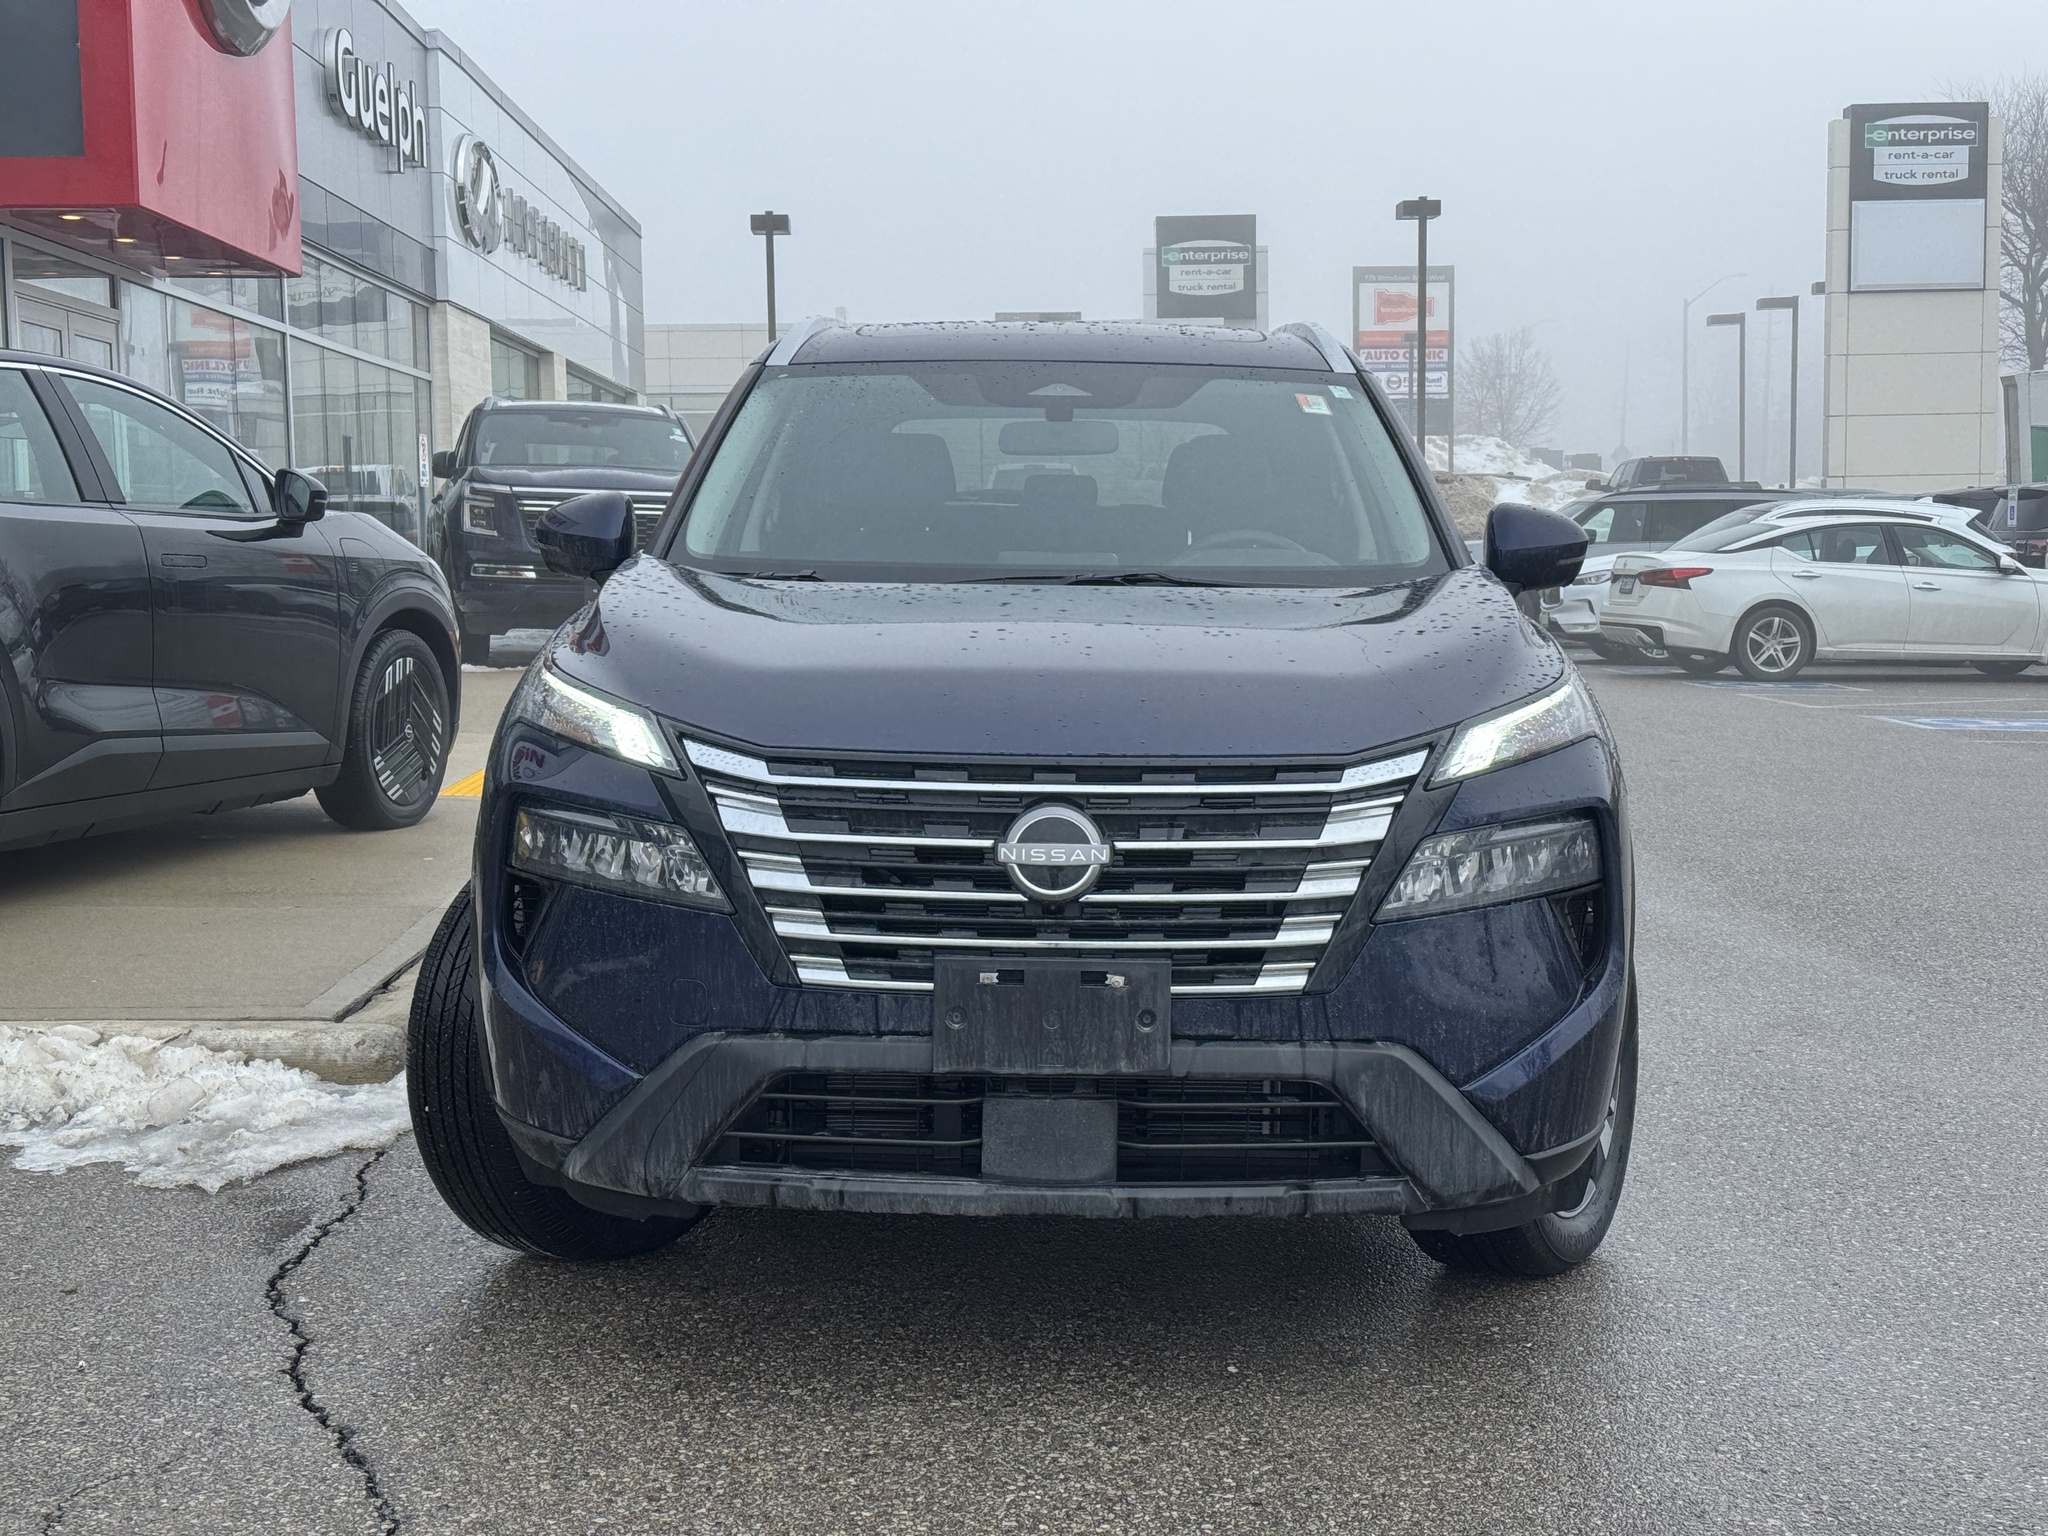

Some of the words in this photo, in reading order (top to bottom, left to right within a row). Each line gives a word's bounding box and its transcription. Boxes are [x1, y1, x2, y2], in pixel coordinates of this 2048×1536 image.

[334, 27, 428, 174] Guelph
[1870, 126, 1976, 143] enterprise
[1888, 150, 1955, 160] rent-a-car
[1884, 169, 1918, 180] truck
[1921, 168, 1959, 179] rental
[1167, 249, 1249, 262] enterprise
[1180, 268, 1232, 276] rent-a-car
[1177, 282, 1204, 291] truck
[1206, 282, 1236, 290] rental
[1364, 350, 1400, 360] AUTO
[1000, 847, 1107, 862] NISSAN
